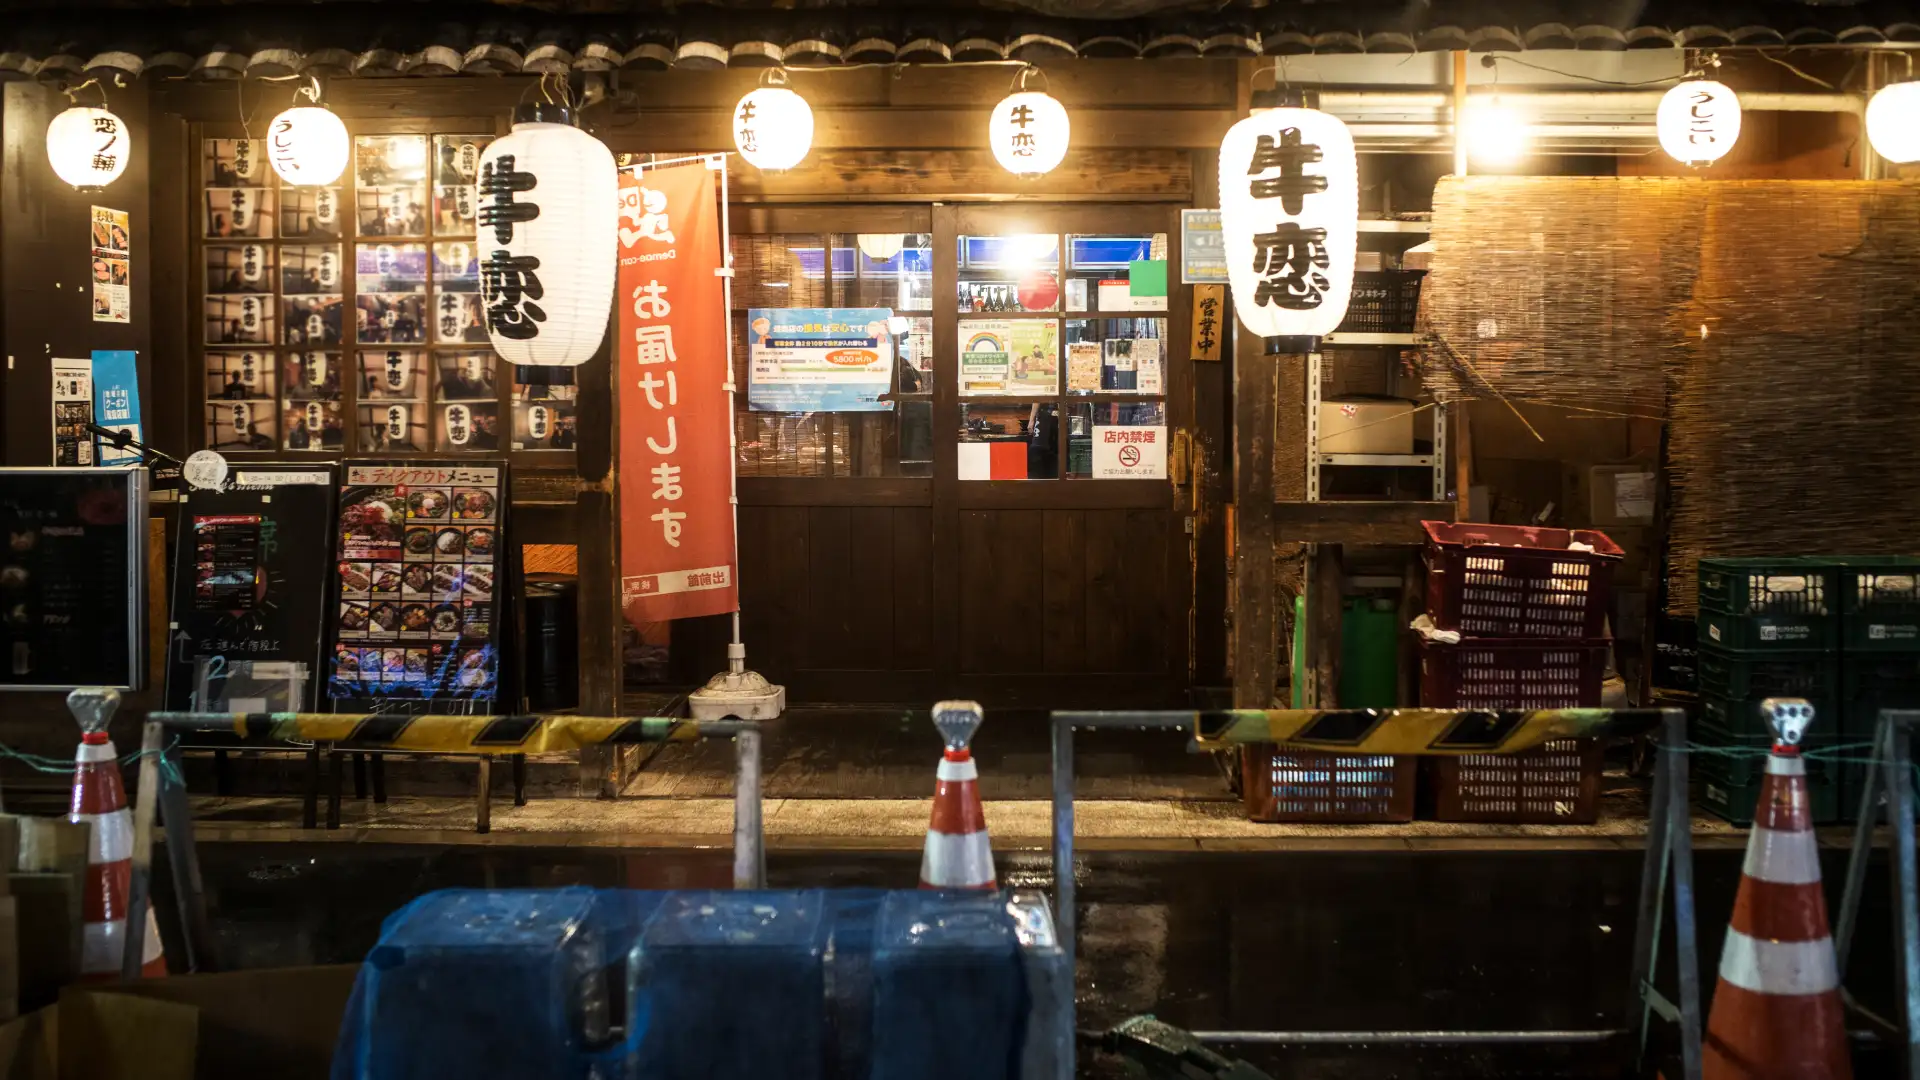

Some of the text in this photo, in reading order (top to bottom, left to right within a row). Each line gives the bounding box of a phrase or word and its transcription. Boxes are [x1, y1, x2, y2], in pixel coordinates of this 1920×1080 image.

[738, 100, 758, 153] 牛恋
[1010, 104, 1036, 157] 牛恋
[1688, 91, 1716, 145] うしこい
[274, 119, 300, 173] うしこい
[1247, 126, 1331, 311] 牛恋
[477, 154, 547, 340] 牛恋
[441, 295, 458, 336] 牛恋
[1197, 297, 1219, 355] 営業中
[105, 398, 127, 409] クーポン
[449, 407, 467, 441] 牛恋
[534, 407, 546, 434] 牛恋
[1103, 431, 1157, 444] 店内禁煙
[371, 469, 496, 484] テイクアウトメニュー
